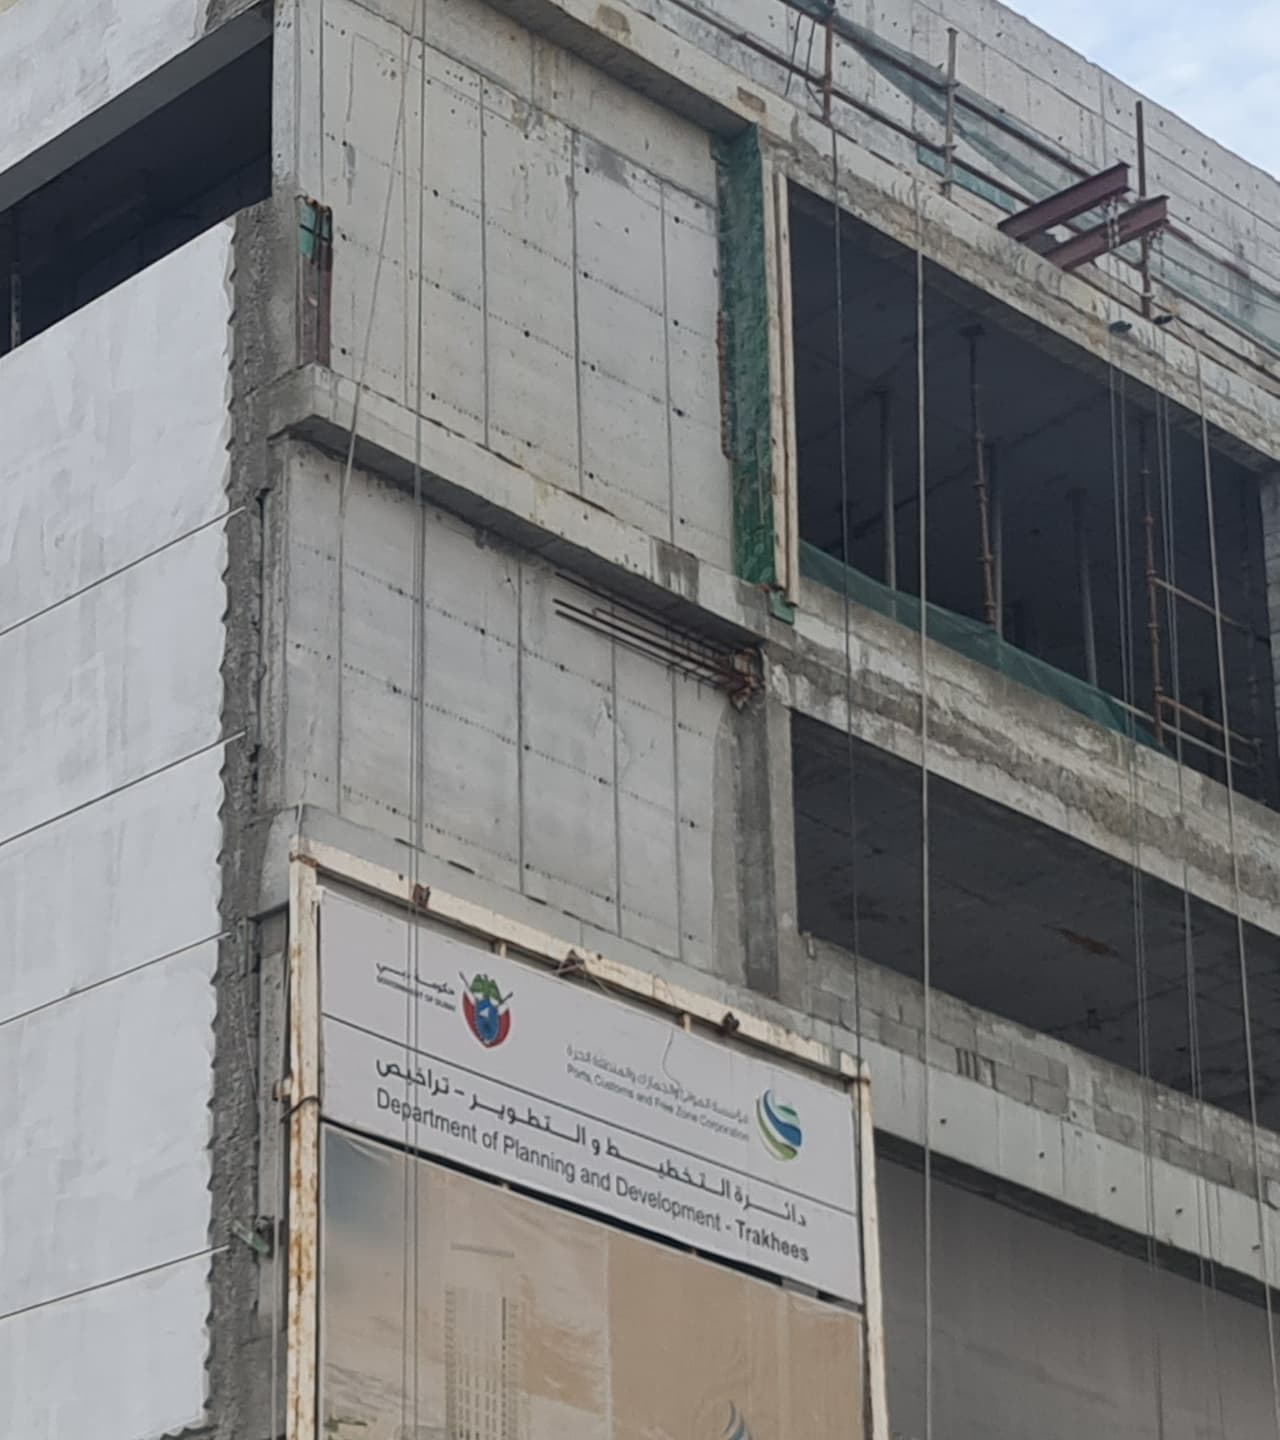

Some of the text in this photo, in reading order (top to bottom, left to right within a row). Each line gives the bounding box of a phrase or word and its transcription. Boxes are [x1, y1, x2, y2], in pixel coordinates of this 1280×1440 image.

[376, 1058, 450, 1097] تراخيص
[469, 1092, 586, 1145] التطوير
[376, 1086, 478, 1145] Department
[482, 1128, 498, 1149] of
[503, 1134, 575, 1184] Planning
[580, 1165, 610, 1193] and
[616, 1175, 721, 1233] Development
[735, 1219, 809, 1263] Trakhees
[605, 1136, 731, 1200] التخطيط
[734, 1186, 807, 1227] دائرة
